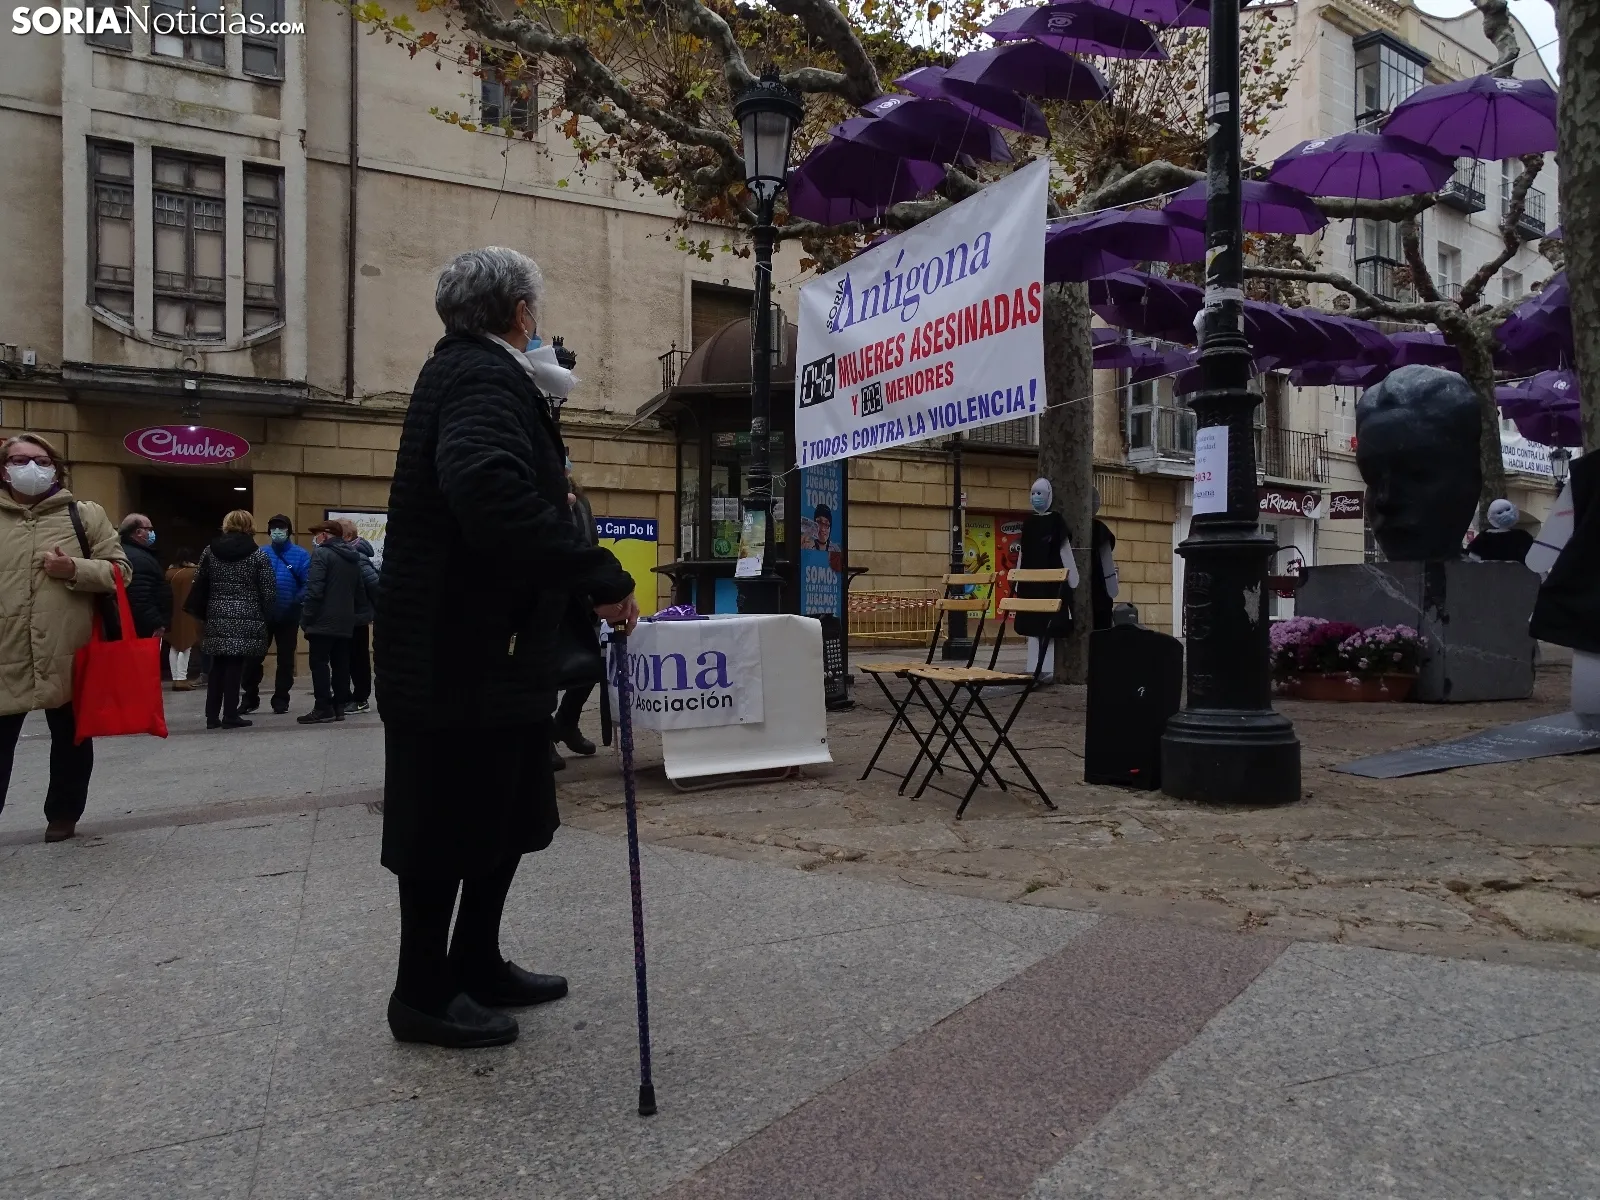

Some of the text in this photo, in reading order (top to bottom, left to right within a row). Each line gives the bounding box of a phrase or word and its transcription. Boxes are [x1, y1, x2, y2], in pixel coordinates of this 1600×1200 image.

[829, 232, 992, 334] Antígona
[826, 278, 846, 331] SORIA
[802, 281, 1042, 405] 046 MUJERES ASESINADAS
[851, 394, 858, 415] Y
[885, 361, 954, 404] MENORES
[852, 416, 905, 451] CONTRA
[908, 411, 926, 437] LA
[928, 378, 1037, 430] VIOLENCIA!
[137, 428, 236, 458] Chuches
[1516, 448, 1538, 460] CONTRA
[1268, 493, 1301, 512] Rincón
[605, 522, 626, 535] Can
[629, 523, 644, 535] Do
[646, 523, 654, 536] It
[805, 565, 838, 585] SOMOS
[635, 691, 733, 713] Asociación
